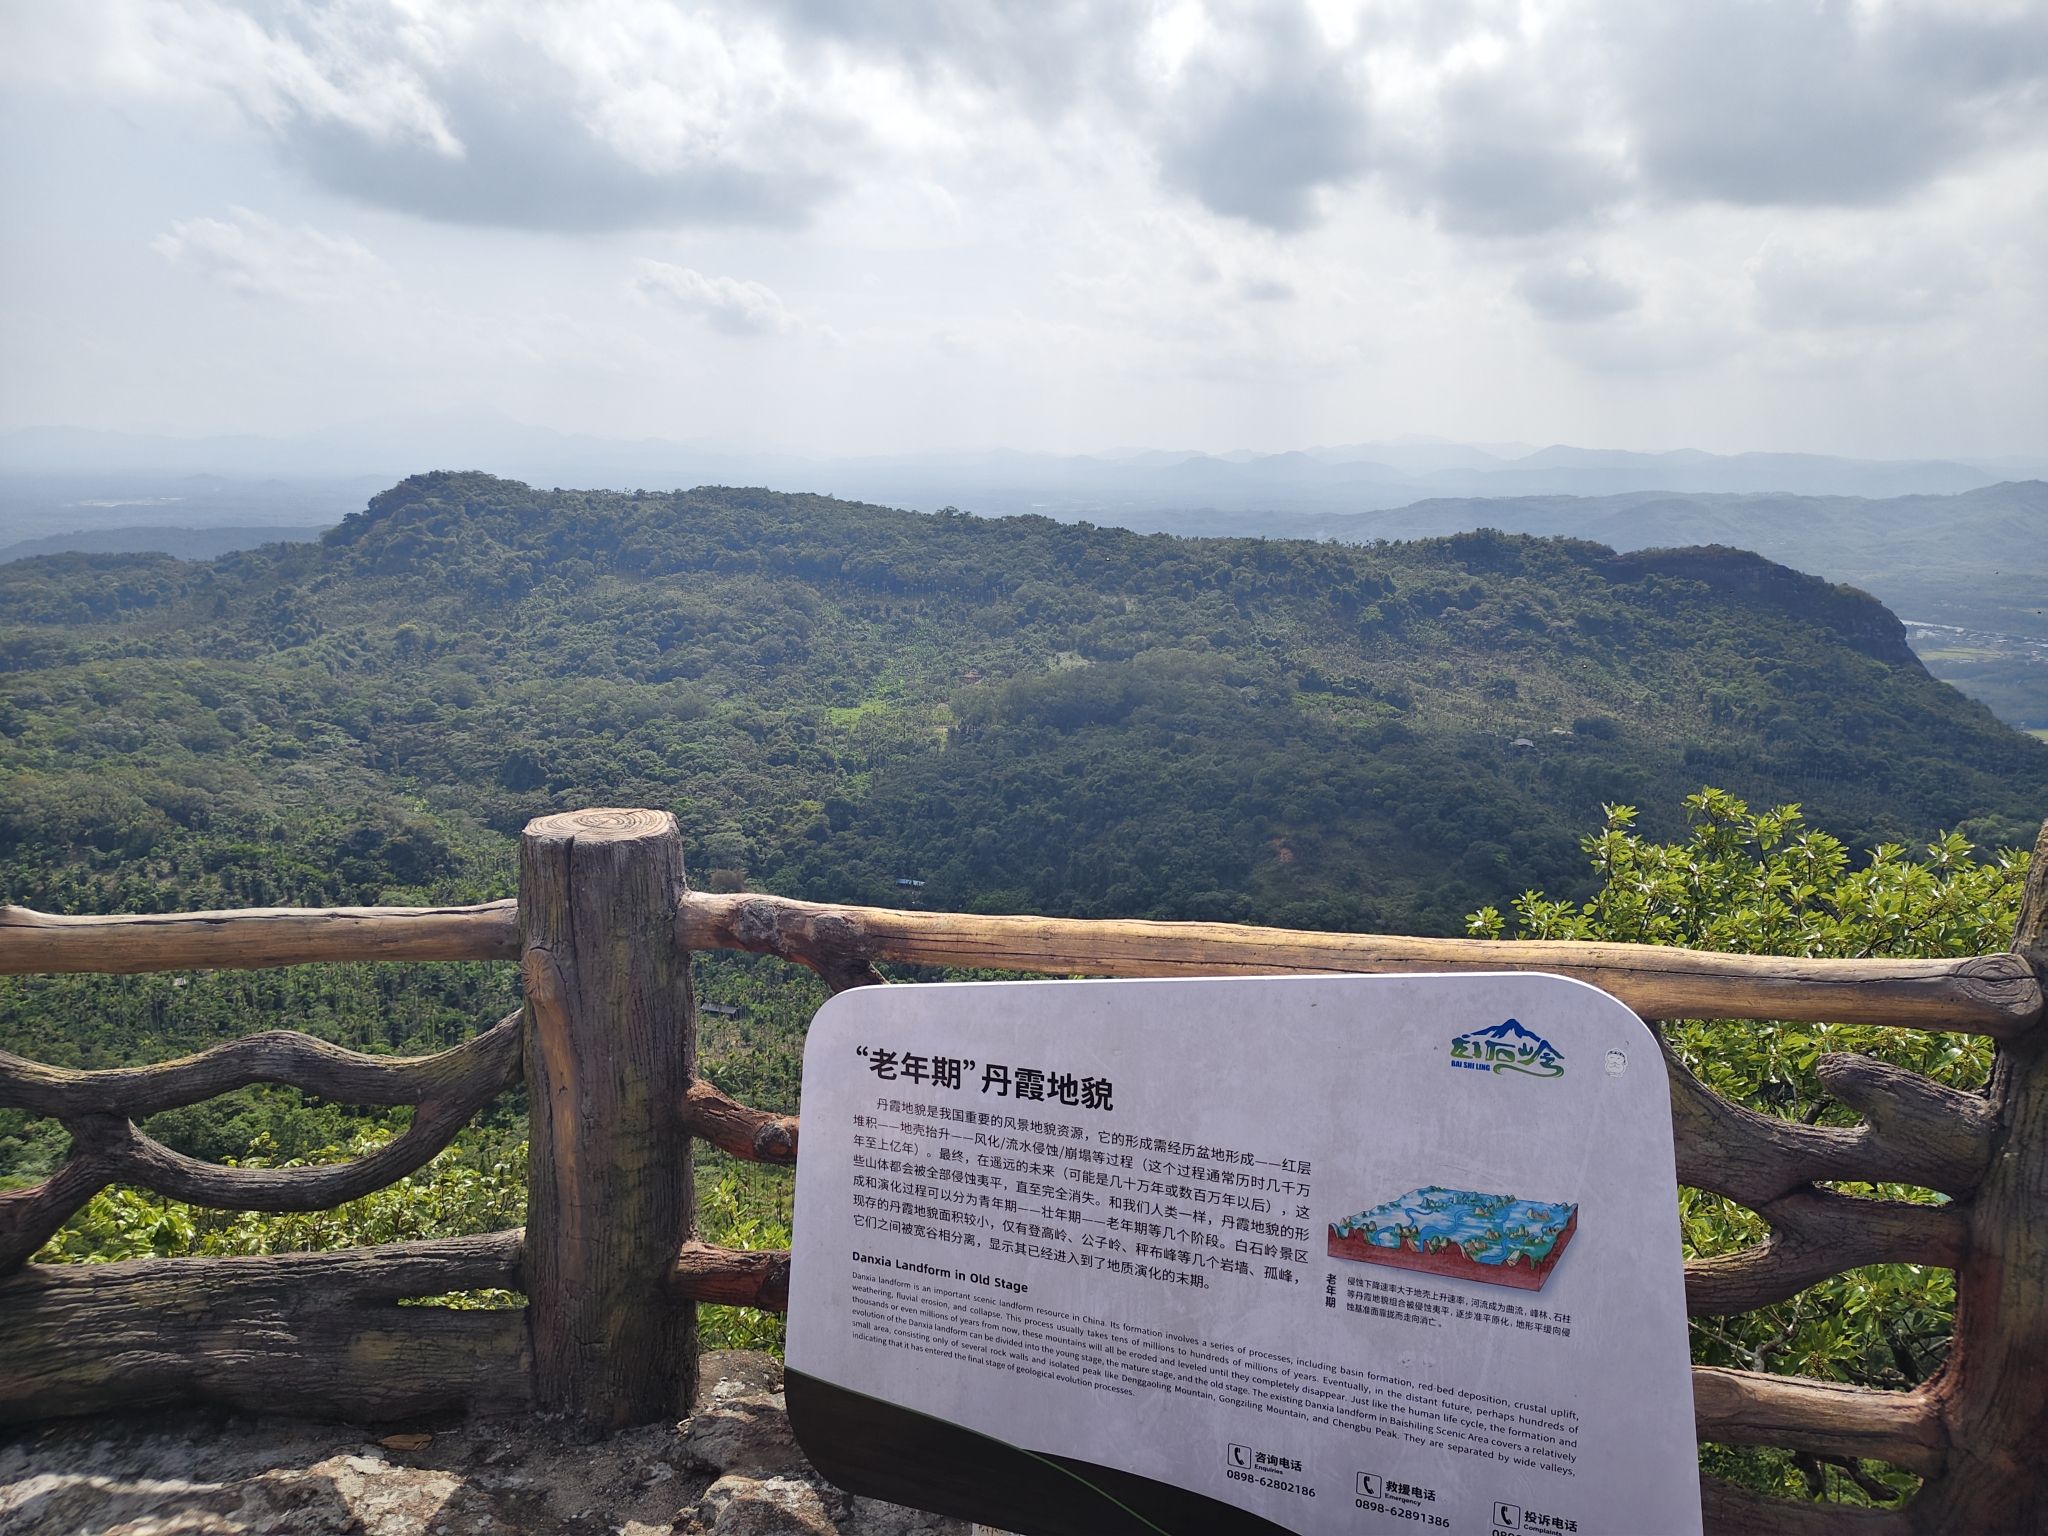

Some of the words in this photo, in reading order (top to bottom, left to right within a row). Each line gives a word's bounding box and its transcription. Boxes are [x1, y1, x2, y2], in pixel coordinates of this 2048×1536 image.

[856, 1045, 1114, 1112] “老年期”丹霞地貌
[1451, 1060, 1462, 1068] BAI
[1464, 1061, 1475, 1069] SHI
[1476, 1063, 1491, 1071] LING
[852, 1251, 892, 1267] Danxia
[896, 1258, 951, 1278] Landform
[955, 1269, 966, 1281] in
[970, 1272, 990, 1286] Old
[994, 1277, 1028, 1294] Stage
[1325, 1272, 1338, 1309] 老年期
[852, 1271, 876, 1282] Danxia
[878, 1275, 911, 1289] landform
[933, 1286, 971, 1301] important
[973, 1295, 996, 1306] scenic
[999, 1298, 1034, 1313] landform
[1036, 1307, 1070, 1320] resource
[1123, 1322, 1163, 1338] formation
[1165, 1331, 1199, 1345] involves
[1210, 1341, 1235, 1352] series
[1296, 1356, 1337, 1374] including
[1340, 1365, 1364, 1378] basin
[1514, 1401, 1547, 1414] crustal
[852, 1331, 887, 1347] indicating
[888, 1338, 903, 1348] that
[911, 1342, 924, 1352] has
[924, 1347, 953, 1358] entered
[954, 1351, 967, 1361] the
[968, 1354, 984, 1365] final
[985, 1359, 1006, 1370] stage
[1016, 1366, 1055, 1380] geological
[1055, 1374, 1092, 1387] evolution
[852, 1295, 889, 1309] thousands
[900, 1306, 918, 1315] even
[919, 1309, 949, 1321] millions
[959, 1317, 980, 1327] years
[981, 1320, 1000, 1331] from
[1022, 1328, 1043, 1340] these
[1045, 1334, 1086, 1348] mountains
[1088, 1342, 1102, 1351] will
[1104, 1345, 1114, 1354] all
[1129, 1351, 1158, 1363] eroded
[1159, 1357, 1176, 1366] and
[1177, 1359, 1207, 1373] leveled
[1209, 1367, 1229, 1378] until
[1231, 1370, 1250, 1383] they
[1252, 1376, 1300, 1393] completely
[1350, 1395, 1369, 1406] Just
[1372, 1398, 1388, 1410] like
[1391, 1403, 1406, 1414] the
[1408, 1406, 1440, 1421] human
[1443, 1413, 1458, 1424] life
[1489, 1423, 1506, 1434] the
[1508, 1426, 1556, 1444] formation
[1558, 1438, 1577, 1448] and
[896, 1291, 918, 1302] fluvial
[952, 1304, 967, 1312] and
[1006, 1312, 1022, 1323] This
[1024, 1318, 1054, 1329] process
[1056, 1324, 1084, 1337] usually
[1087, 1329, 1108, 1340] takes
[1111, 1334, 1128, 1344] tens
[1142, 1341, 1175, 1354] millions
[1190, 1349, 1230, 1365] hundreds
[1244, 1362, 1278, 1374] millions
[1387, 1388, 1403, 1399] the
[1405, 1392, 1438, 1407] distant
[1476, 1408, 1515, 1422] perhaps
[1518, 1414, 1565, 1432] hundreds
[852, 1308, 885, 1320] evolution
[908, 1318, 933, 1330] Danxia
[934, 1323, 968, 1337] landform
[969, 1332, 983, 1340] can
[995, 1335, 1023, 1348] divided
[1024, 1341, 1040, 1351] into
[1041, 1345, 1054, 1354] the
[1055, 1349, 1080, 1362] young
[1106, 1358, 1119, 1368] the
[1121, 1362, 1150, 1374] mature
[1177, 1374, 1193, 1383] and
[1194, 1376, 1209, 1386] the
[1210, 1380, 1224, 1389] old
[1252, 1388, 1269, 1398] The
[1269, 1393, 1303, 1408] existing
[1305, 1399, 1334, 1412] Danxia
[1336, 1405, 1377, 1421] landform
[1390, 1416, 1434, 1435] Baishiling
[1436, 1425, 1466, 1440] Scenic
[1467, 1433, 1489, 1444] Area
[1491, 1439, 1522, 1451] covers
[1532, 1447, 1577, 1464] relatively
[852, 1320, 871, 1330] small
[894, 1328, 930, 1343] consisting
[932, 1336, 949, 1347] only
[961, 1342, 988, 1353] several
[990, 1348, 1007, 1357] rock
[1009, 1352, 1029, 1362] walls
[1031, 1357, 1046, 1365] and
[1049, 1358, 1080, 1372] isolated
[1082, 1367, 1102, 1377] peak
[1104, 1369, 1119, 1380] like
[1121, 1374, 1172, 1393] Denggaoling
[1218, 1394, 1263, 1413] Gongziling
[1312, 1415, 1329, 1425] and
[1332, 1418, 1372, 1434] Chengbu
[1403, 1432, 1426, 1446] They
[1429, 1439, 1444, 1449] are
[1447, 1443, 1494, 1459] separated
[1513, 1456, 1536, 1468] wide
[1254, 1451, 1303, 1472] 咨询电话
[1254, 1464, 1284, 1475] Enquiries
[1226, 1469, 1316, 1498] 0898-62802186
[1384, 1493, 1421, 1507] Emergency
[1385, 1480, 1436, 1502] 救援电话
[1355, 1498, 1450, 1528] 0898-62891386
[1523, 1523, 1562, 1536] Complaints
[1524, 1511, 1578, 1532] 投诉电话
